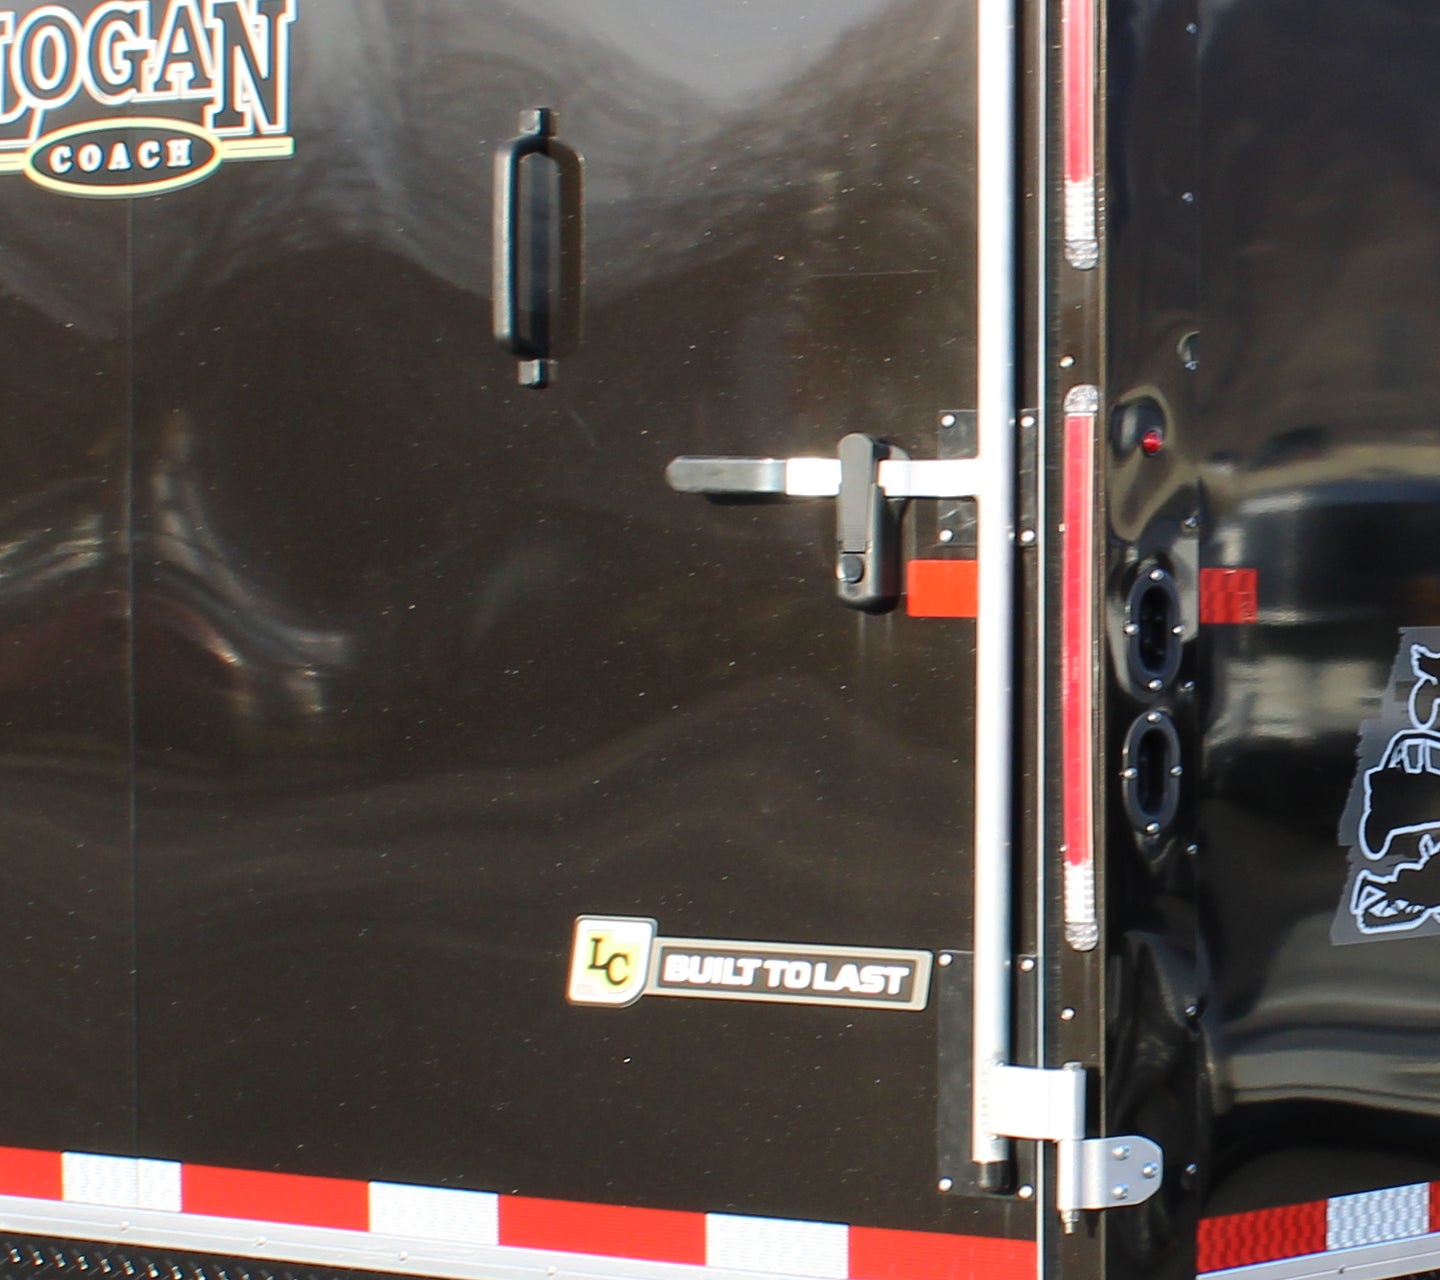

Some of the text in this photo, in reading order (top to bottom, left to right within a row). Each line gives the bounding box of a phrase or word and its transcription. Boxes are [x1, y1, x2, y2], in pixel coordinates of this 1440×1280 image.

[49, 137, 194, 175] COACH
[587, 937, 631, 987] LC
[663, 953, 911, 995] BUILT TO LAST
